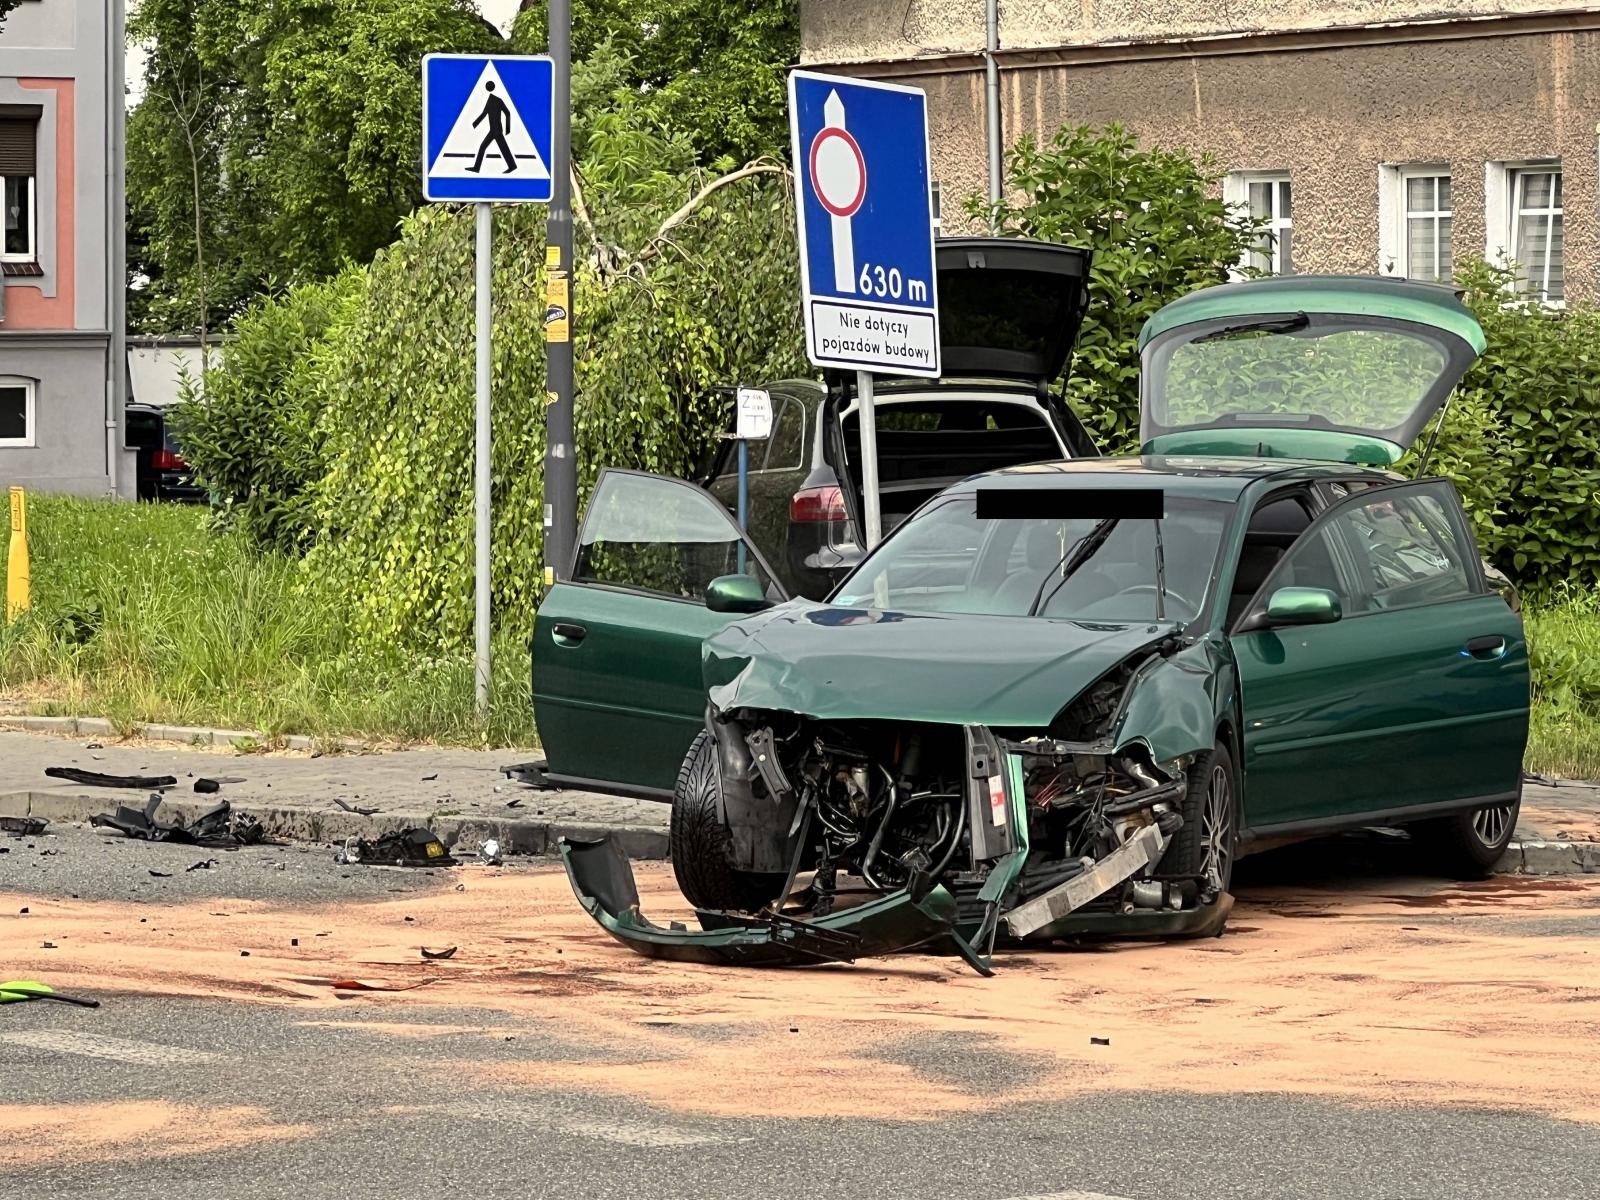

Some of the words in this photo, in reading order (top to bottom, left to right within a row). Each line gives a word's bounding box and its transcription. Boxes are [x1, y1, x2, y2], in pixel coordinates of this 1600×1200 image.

[860, 264, 902, 298] 630
[908, 279, 927, 302] m
[840, 311, 860, 328] Nie
[865, 315, 908, 339] dotyczy
[822, 335, 880, 354] pojazdów
[885, 340, 929, 364] budowy
